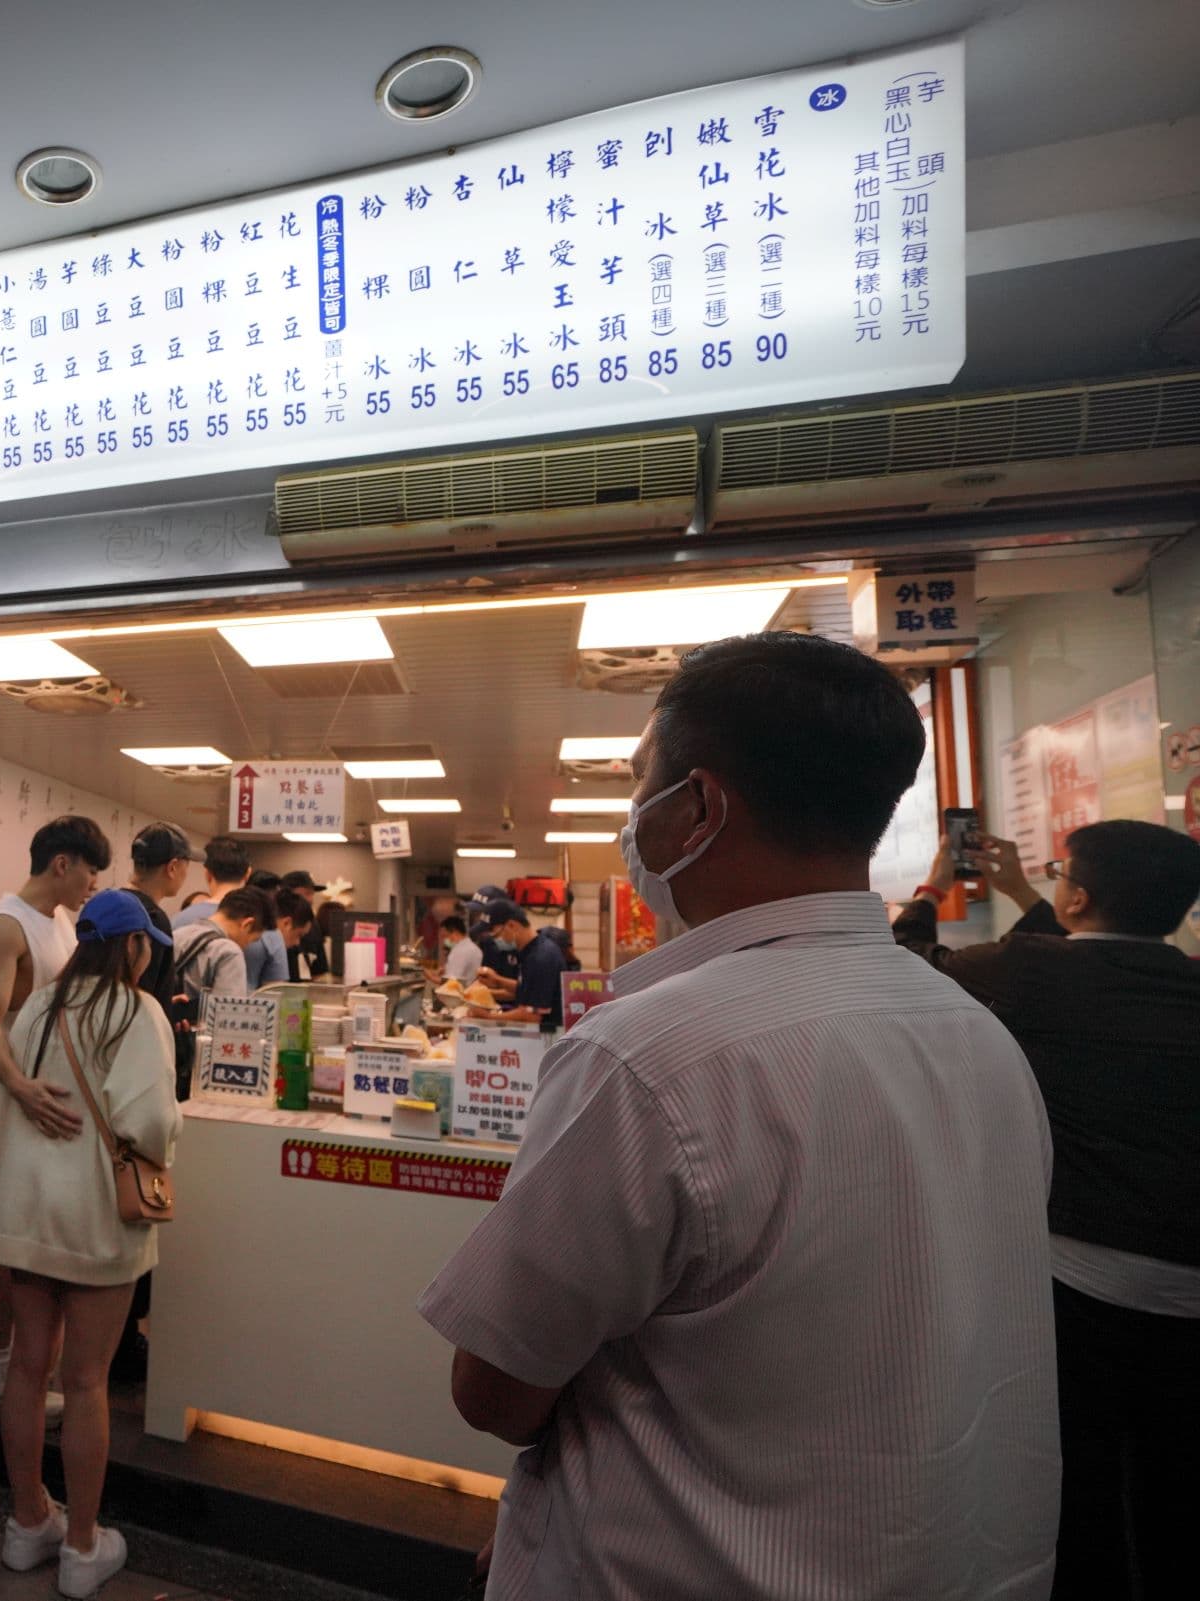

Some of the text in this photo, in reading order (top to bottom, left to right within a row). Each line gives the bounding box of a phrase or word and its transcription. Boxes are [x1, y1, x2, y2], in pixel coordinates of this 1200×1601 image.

[815, 88, 840, 107] 冰
[161, 238, 189, 443] 粉圓豆花 55
[201, 230, 228, 437] 粉粿豆花 55
[239, 222, 268, 432] 紅豆豆花 55
[279, 212, 306, 426] 花生豆花 55
[359, 195, 391, 415] 粉粿冰 55
[404, 185, 437, 408] 粉圓冰 55
[452, 175, 482, 402] 杏仁冰 55
[497, 165, 530, 396] 仙草冰 55
[546, 150, 580, 389] 檸檬愛玉冰 65
[596, 140, 627, 383] 蜜汁芋頭 85
[853, 152, 882, 343] 其他加料每樣10元
[0, 276, 21, 468] 小薏仁豆花 55
[28, 268, 52, 463] 湯圓豆花 55
[61, 261, 84, 458] 芋圓豆花 55
[92, 254, 117, 453] 綠豆豆花 55
[127, 248, 153, 448] 大豆豆花 55
[649, 349, 678, 376] 85
[702, 341, 732, 369] 85
[756, 333, 787, 362] 90
[896, 581, 955, 603] 外帶
[896, 608, 958, 632] 取餐
[242, 794, 250, 805] 2
[242, 811, 249, 823] 3
[316, 1153, 393, 1184] 等待區
[354, 1074, 409, 1095] 點餐區
